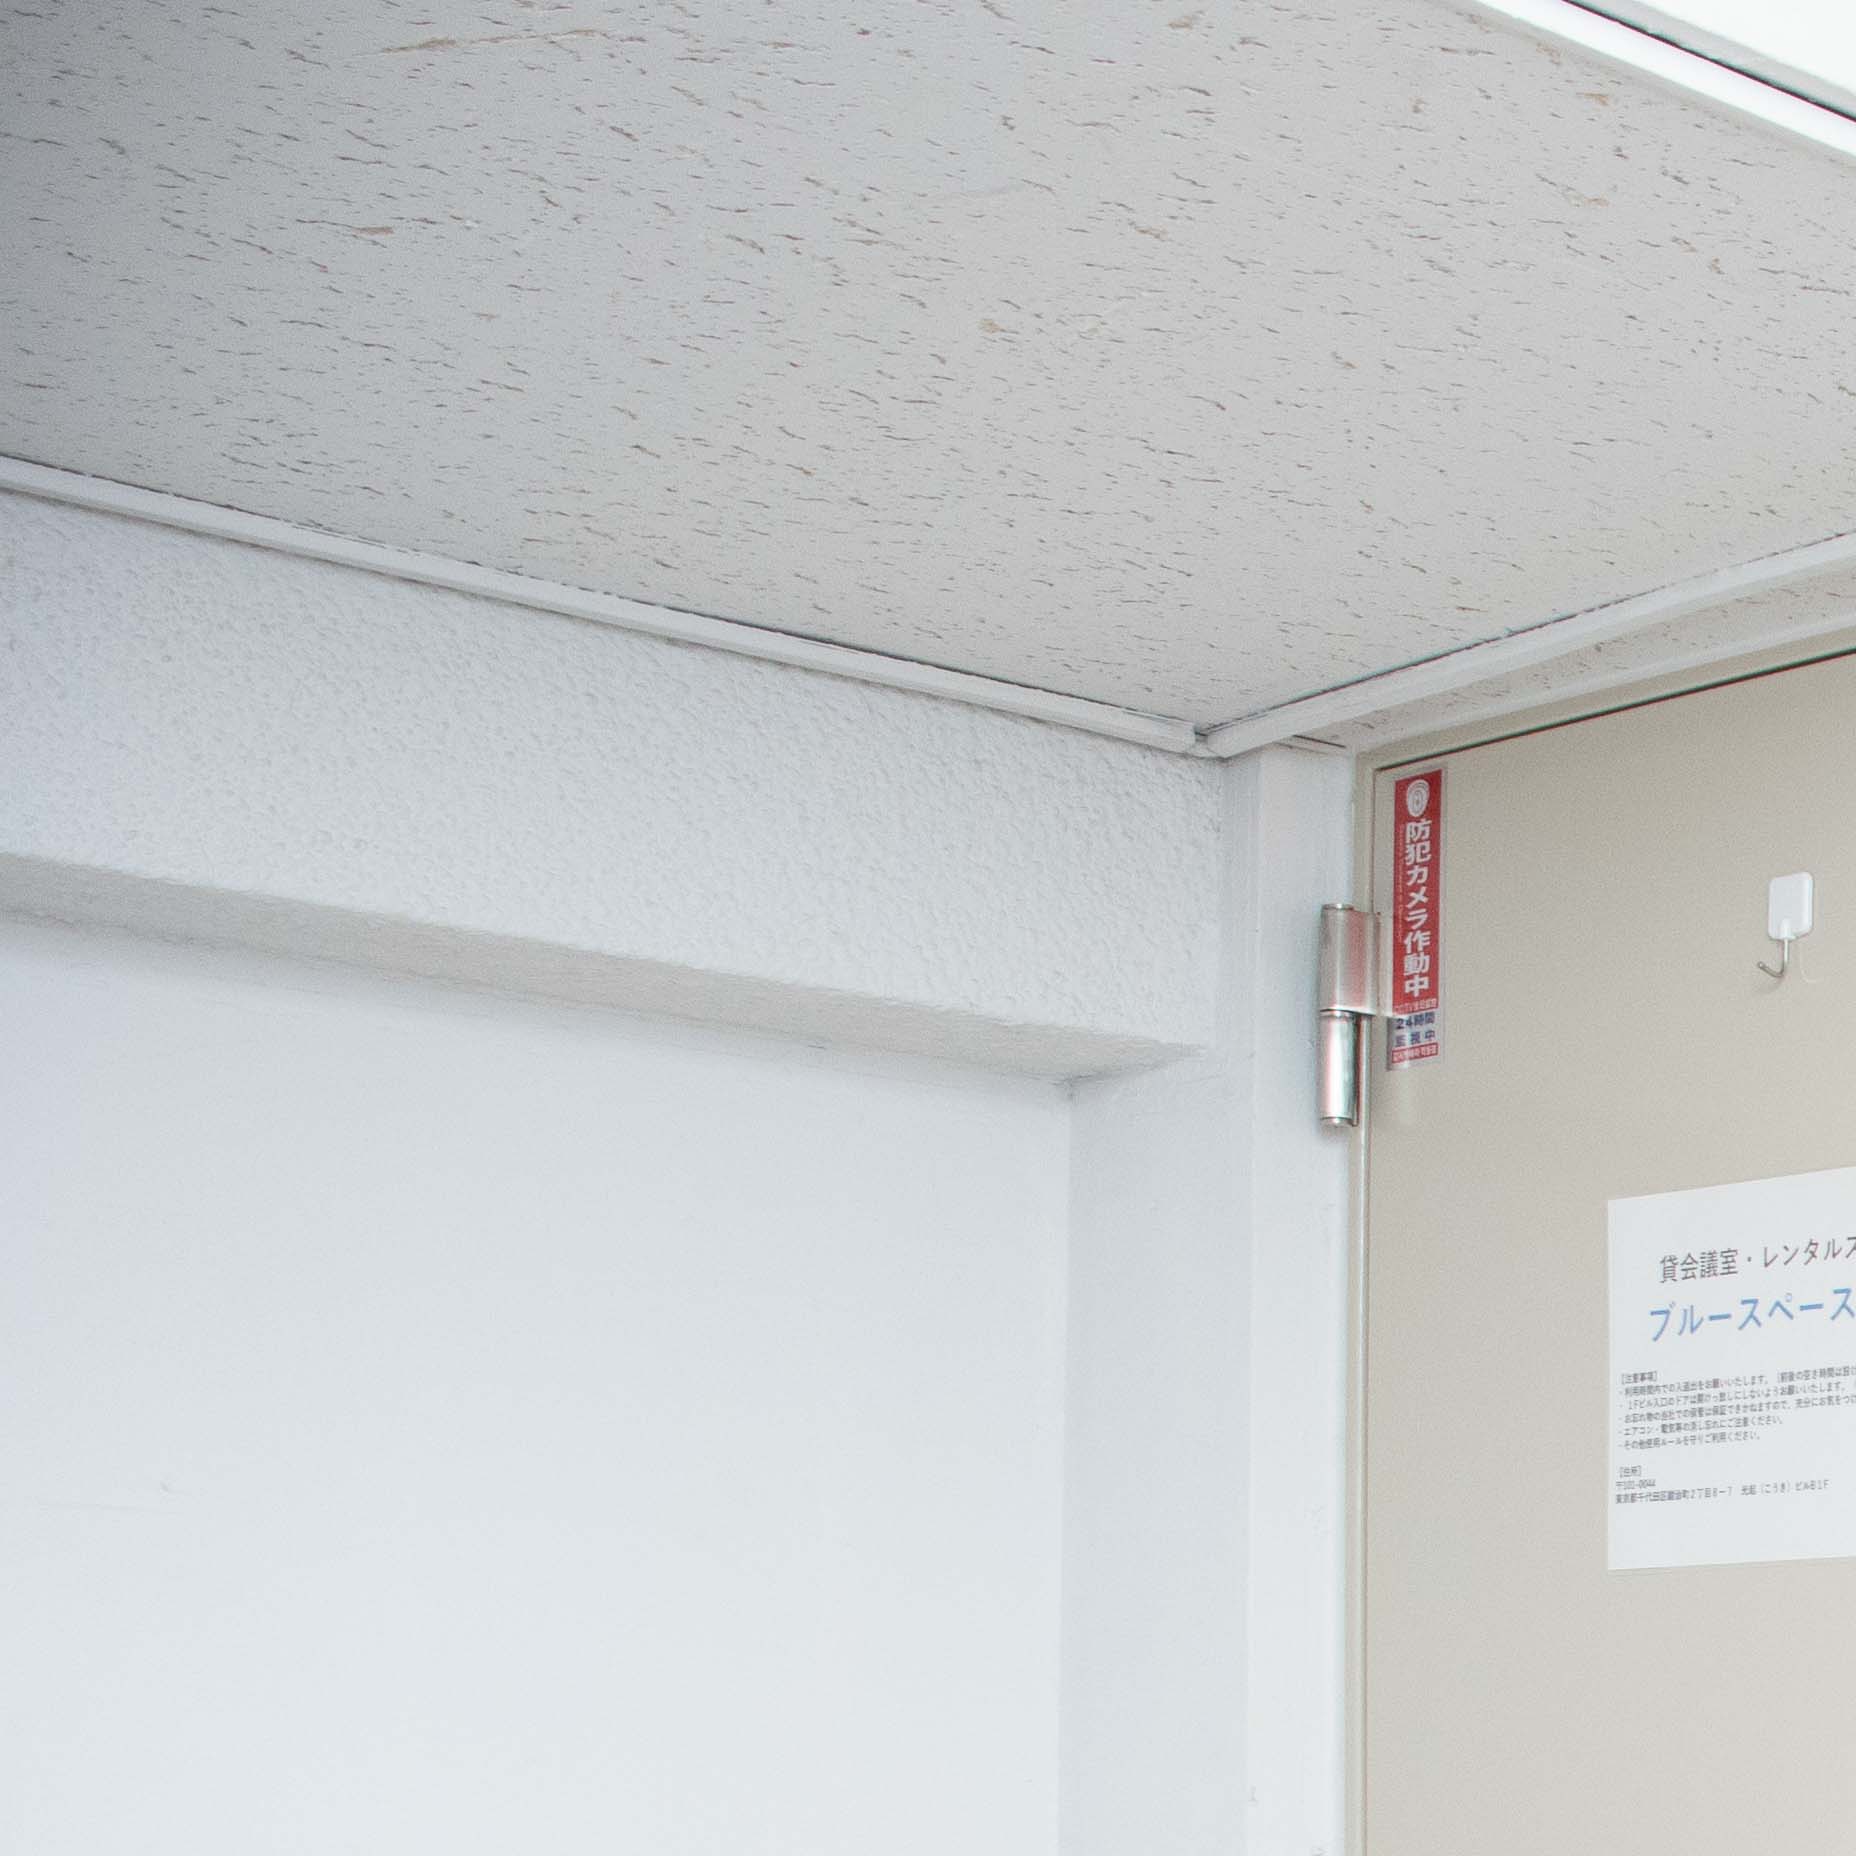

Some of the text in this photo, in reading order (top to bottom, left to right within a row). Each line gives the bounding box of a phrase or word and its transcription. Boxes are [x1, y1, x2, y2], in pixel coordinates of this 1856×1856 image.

[1404, 818, 1432, 998] 防犯カメラ作動中
